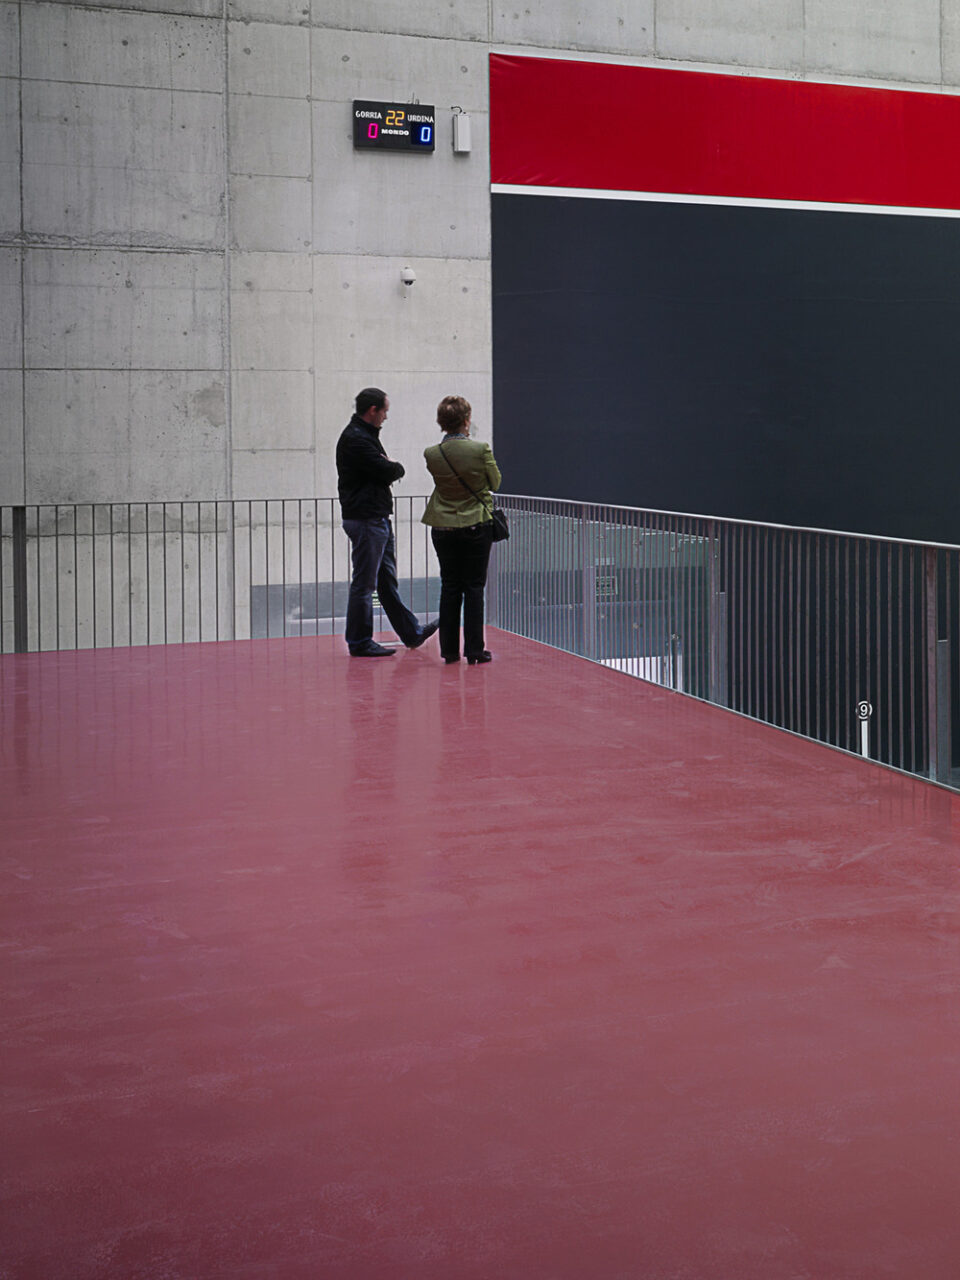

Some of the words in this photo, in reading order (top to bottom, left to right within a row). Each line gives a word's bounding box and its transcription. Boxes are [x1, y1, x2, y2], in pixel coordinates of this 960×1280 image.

[355, 110, 382, 119] GORRIA
[385, 110, 405, 126] 22
[407, 114, 434, 123] URDINA
[368, 123, 378, 139] 0
[381, 128, 409, 136] MONDO
[420, 126, 431, 142] 0
